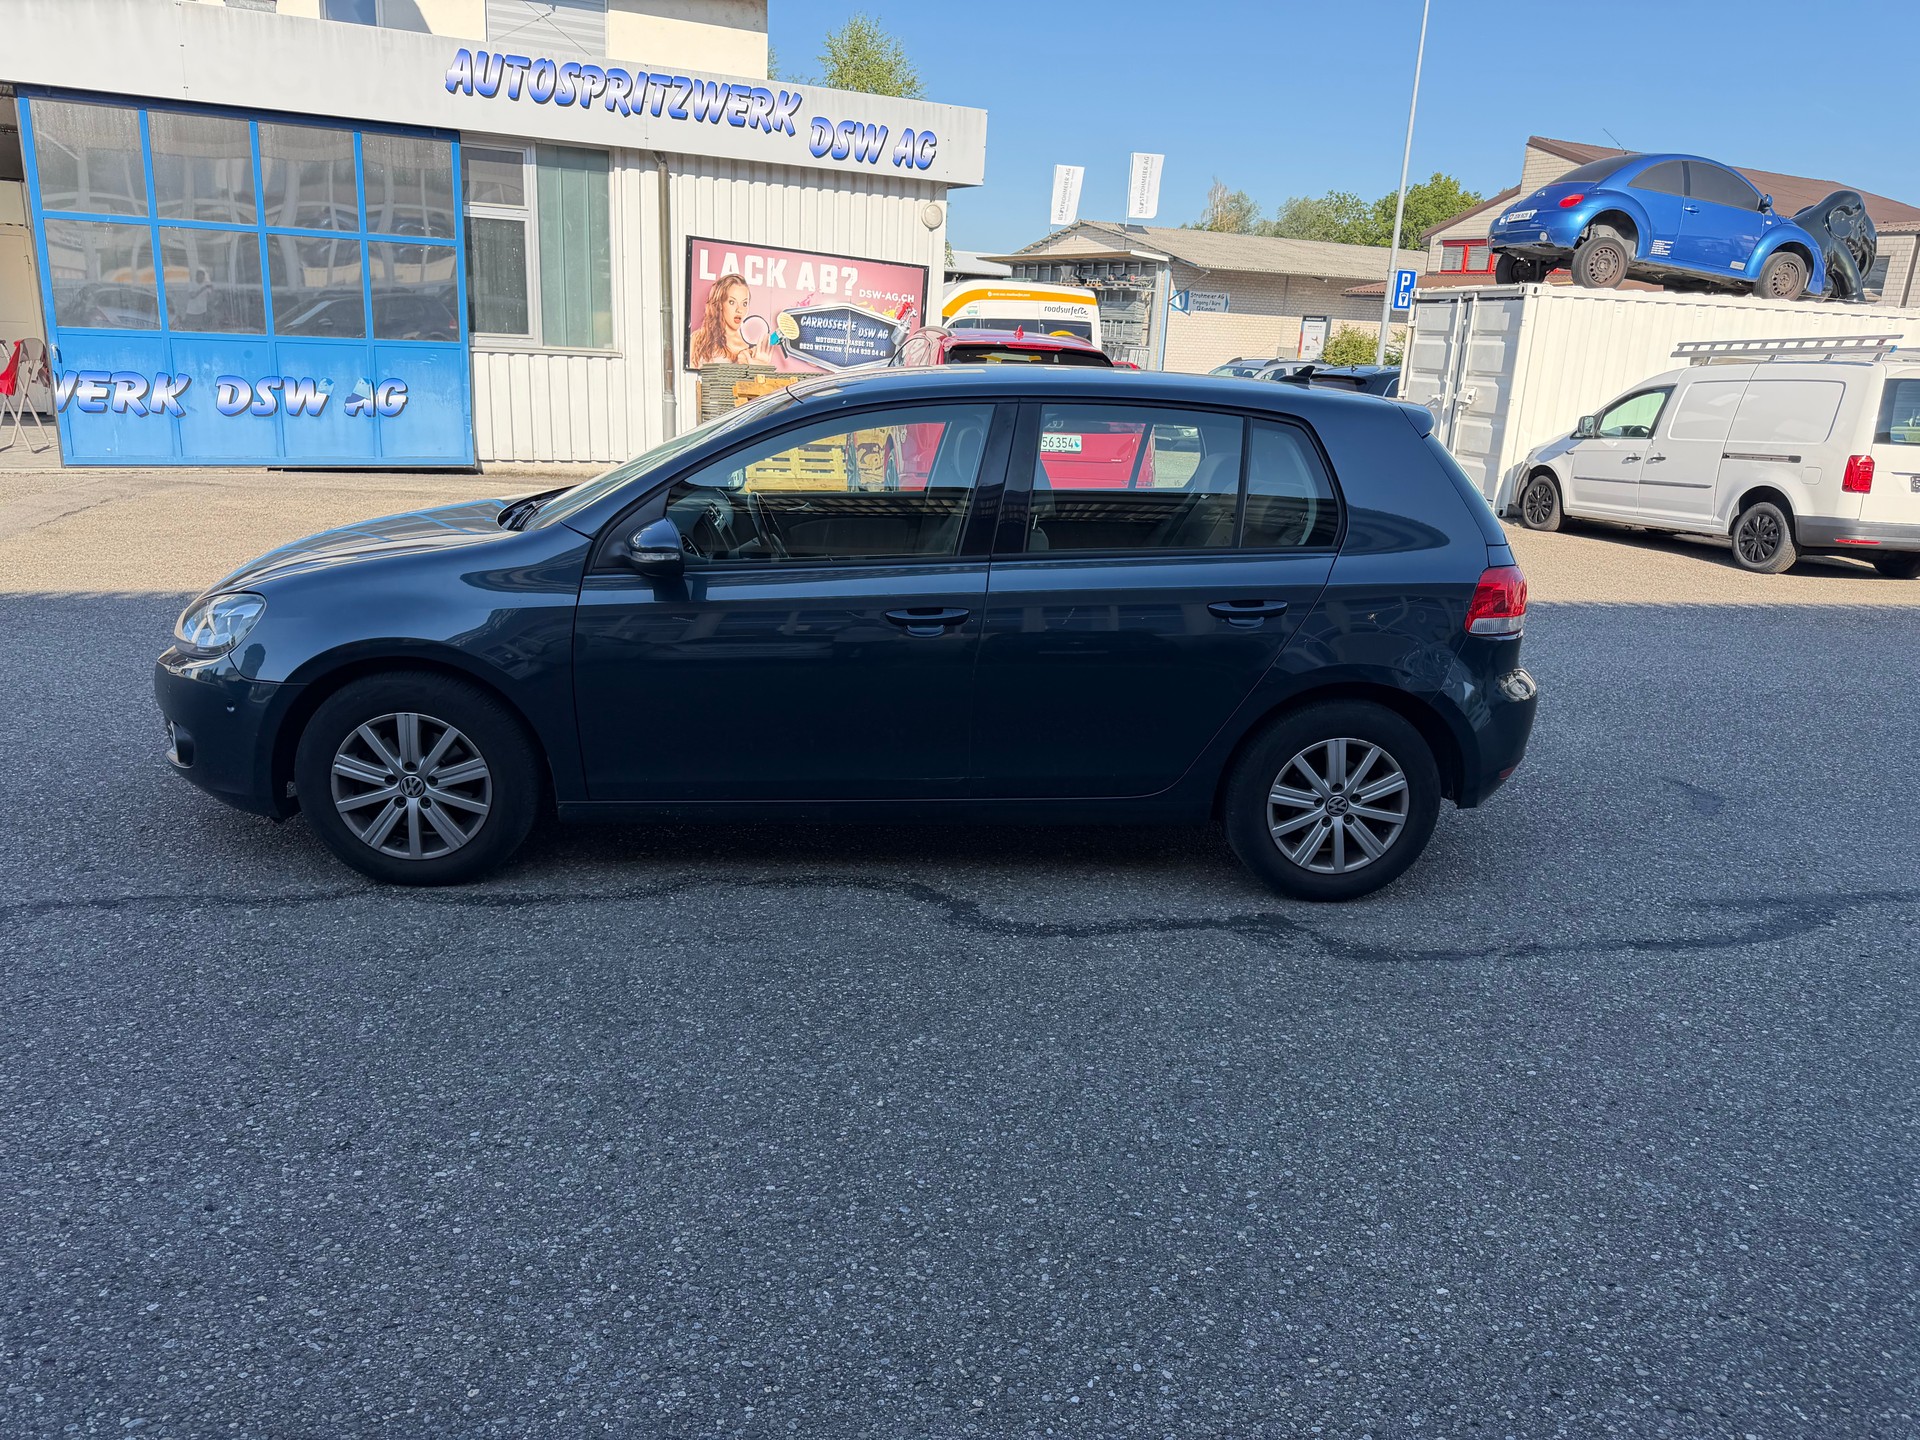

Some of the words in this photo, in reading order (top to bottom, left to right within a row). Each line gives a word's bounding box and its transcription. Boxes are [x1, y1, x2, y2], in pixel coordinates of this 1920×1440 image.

[445, 48, 803, 138] AUTOSPRITZWERK
[808, 116, 888, 164] DSW
[892, 127, 937, 170] AG
[699, 249, 787, 289] LACK
[797, 262, 859, 297] AB?
[1400, 273, 1411, 292] P
[859, 289, 915, 303] DSW-AG.CH
[1044, 305, 1082, 316] roadsurfer
[800, 315, 857, 331] CARROSSERIE
[877, 330, 889, 340] AG
[215, 375, 335, 417] DSW
[344, 376, 408, 418] AG
